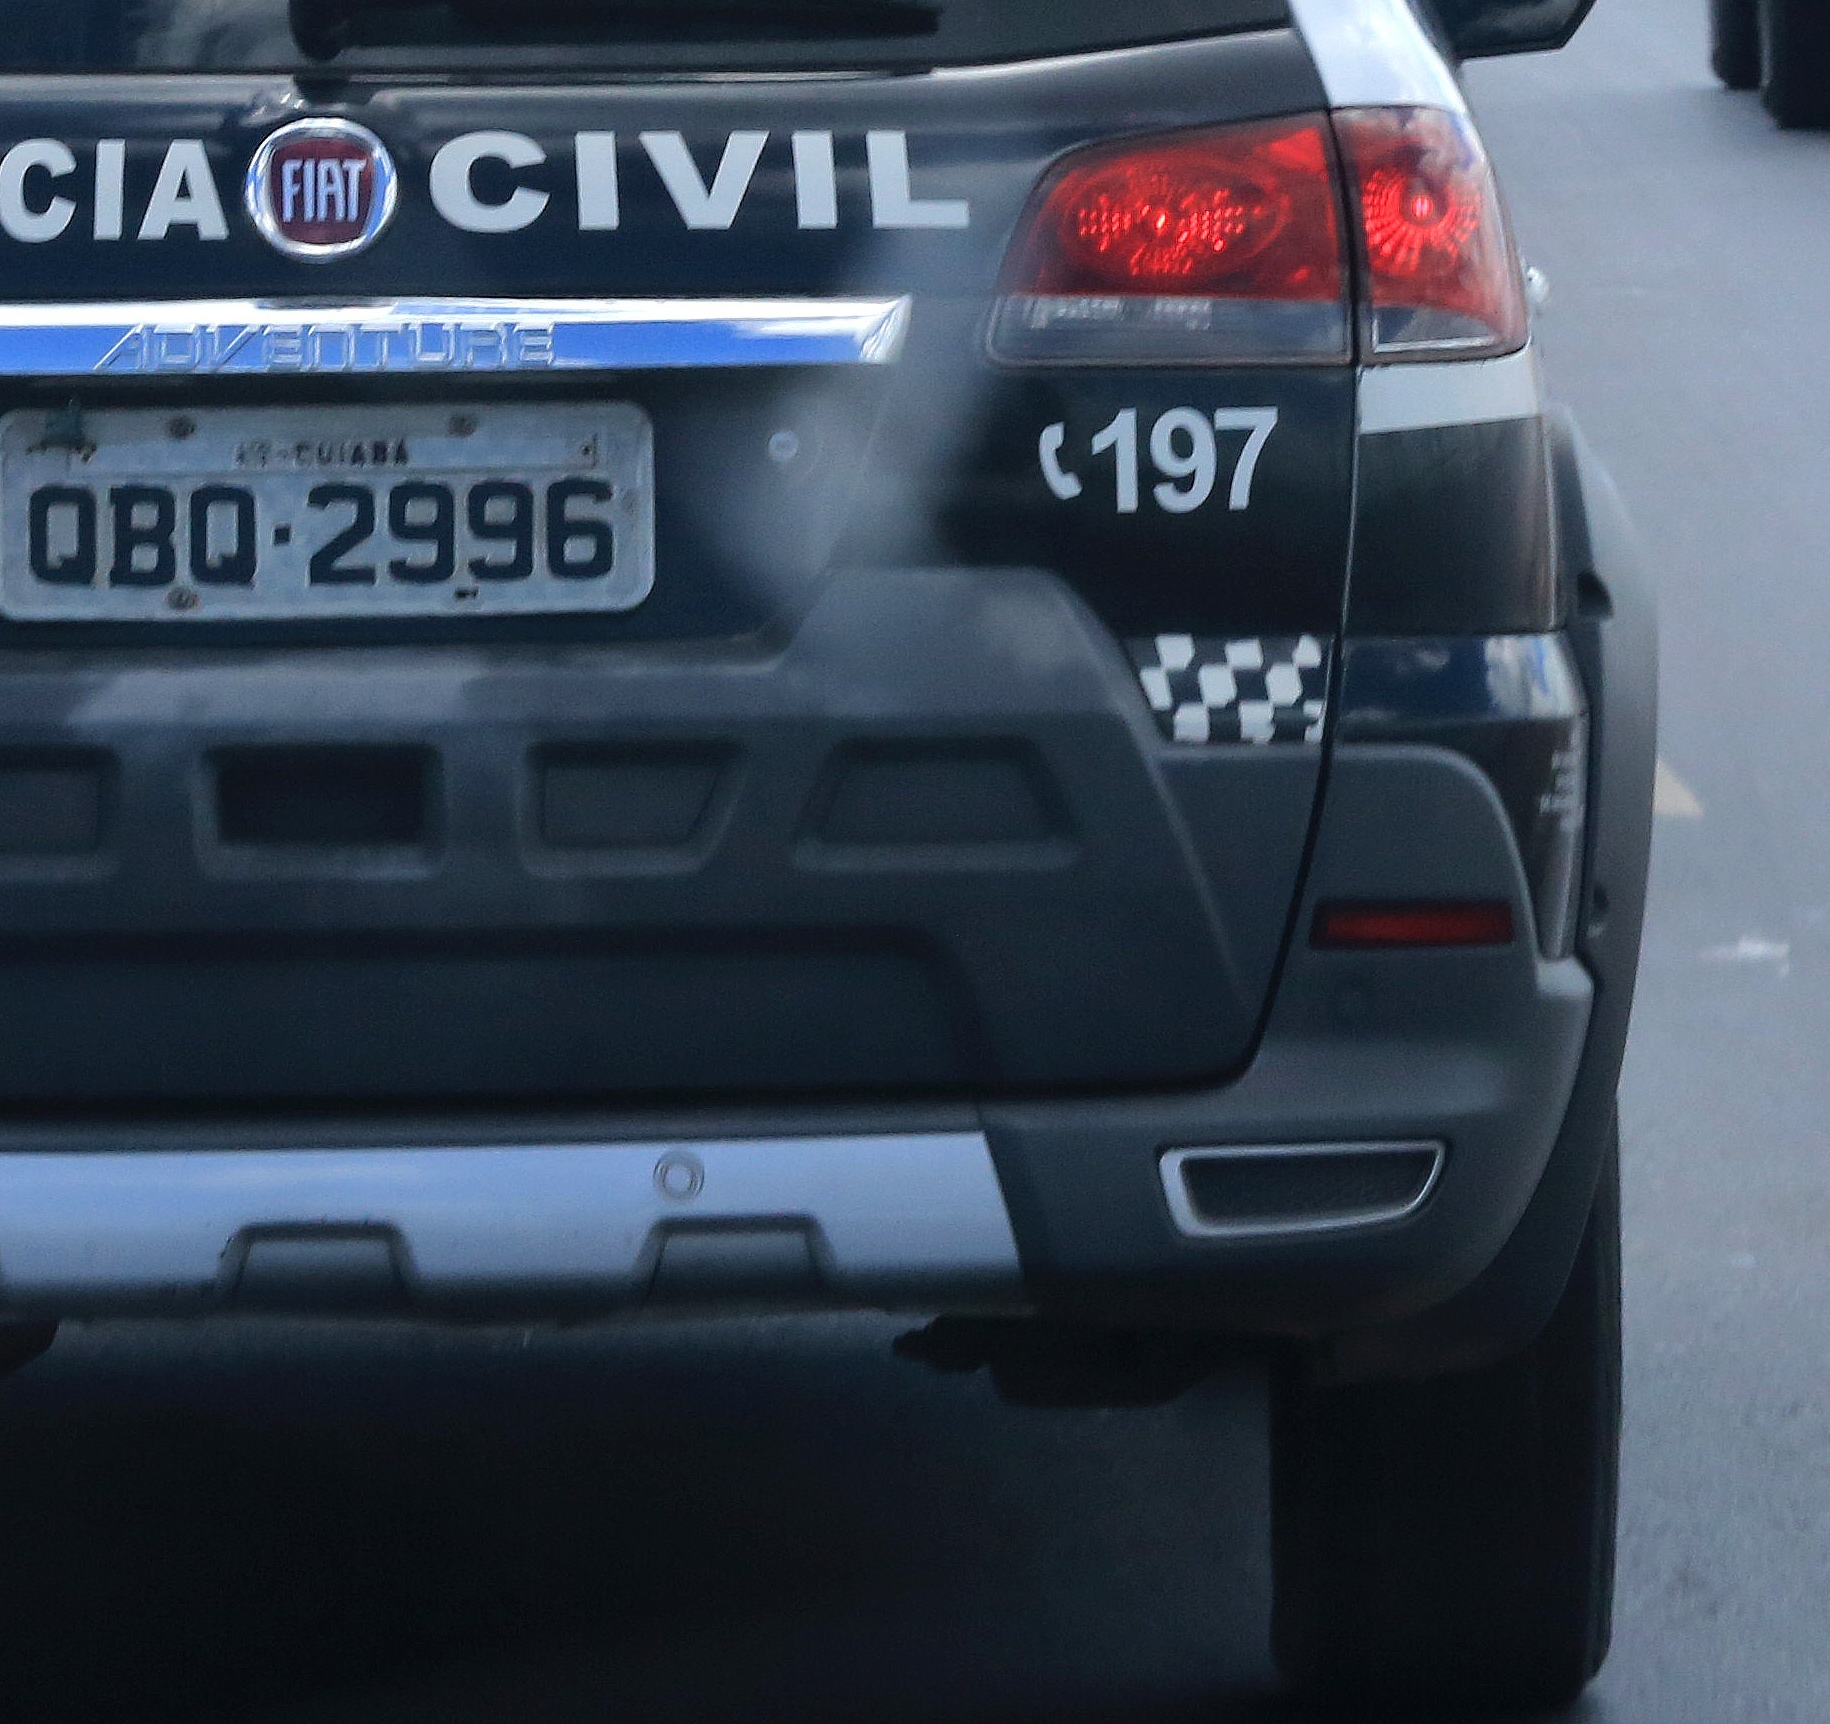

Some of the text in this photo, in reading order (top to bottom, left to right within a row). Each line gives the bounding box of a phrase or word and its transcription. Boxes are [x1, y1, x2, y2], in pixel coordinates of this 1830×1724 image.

[280, 156, 367, 223] FIAT
[429, 130, 971, 233] CIVIL
[93, 322, 556, 372] ADVENTURE
[1090, 406, 1280, 514] 197
